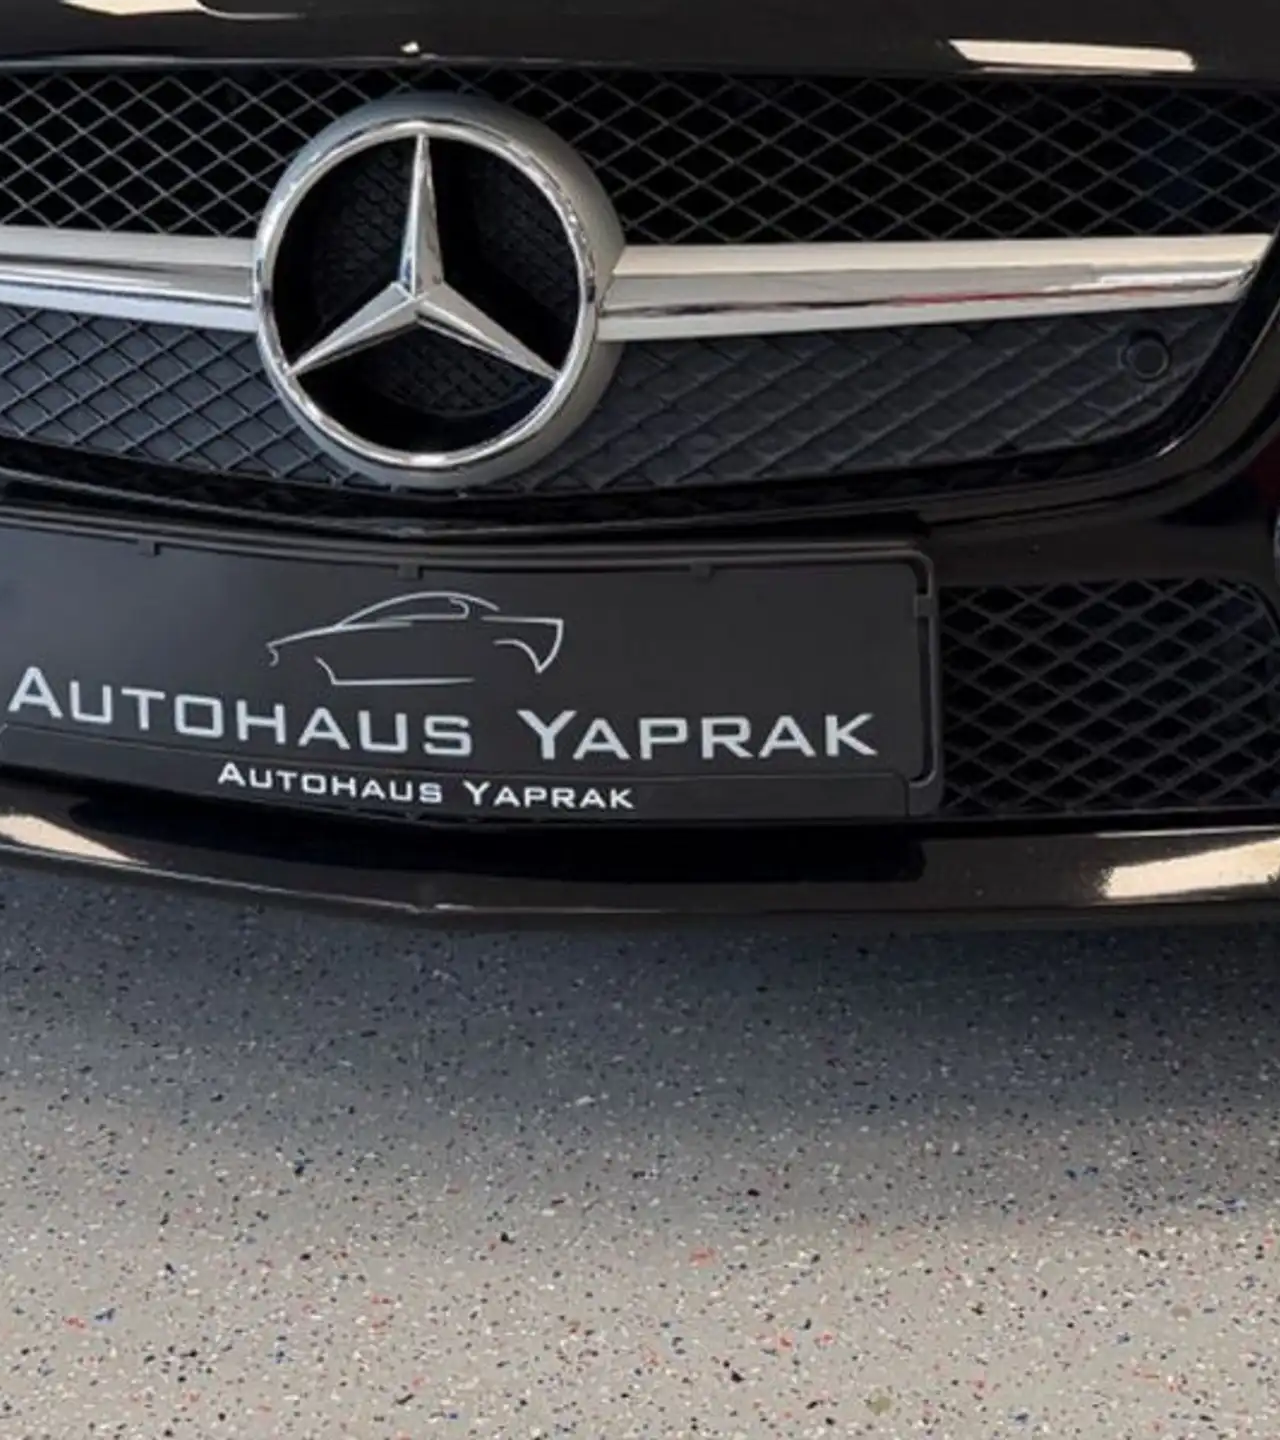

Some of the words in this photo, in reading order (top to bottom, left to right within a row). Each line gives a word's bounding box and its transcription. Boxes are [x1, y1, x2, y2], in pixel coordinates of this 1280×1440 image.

[7, 665, 473, 758] AUTOHAUS
[517, 709, 878, 760] YAPRAK
[217, 761, 444, 804] AUTOHAUS
[463, 780, 635, 809] YAPRAK
